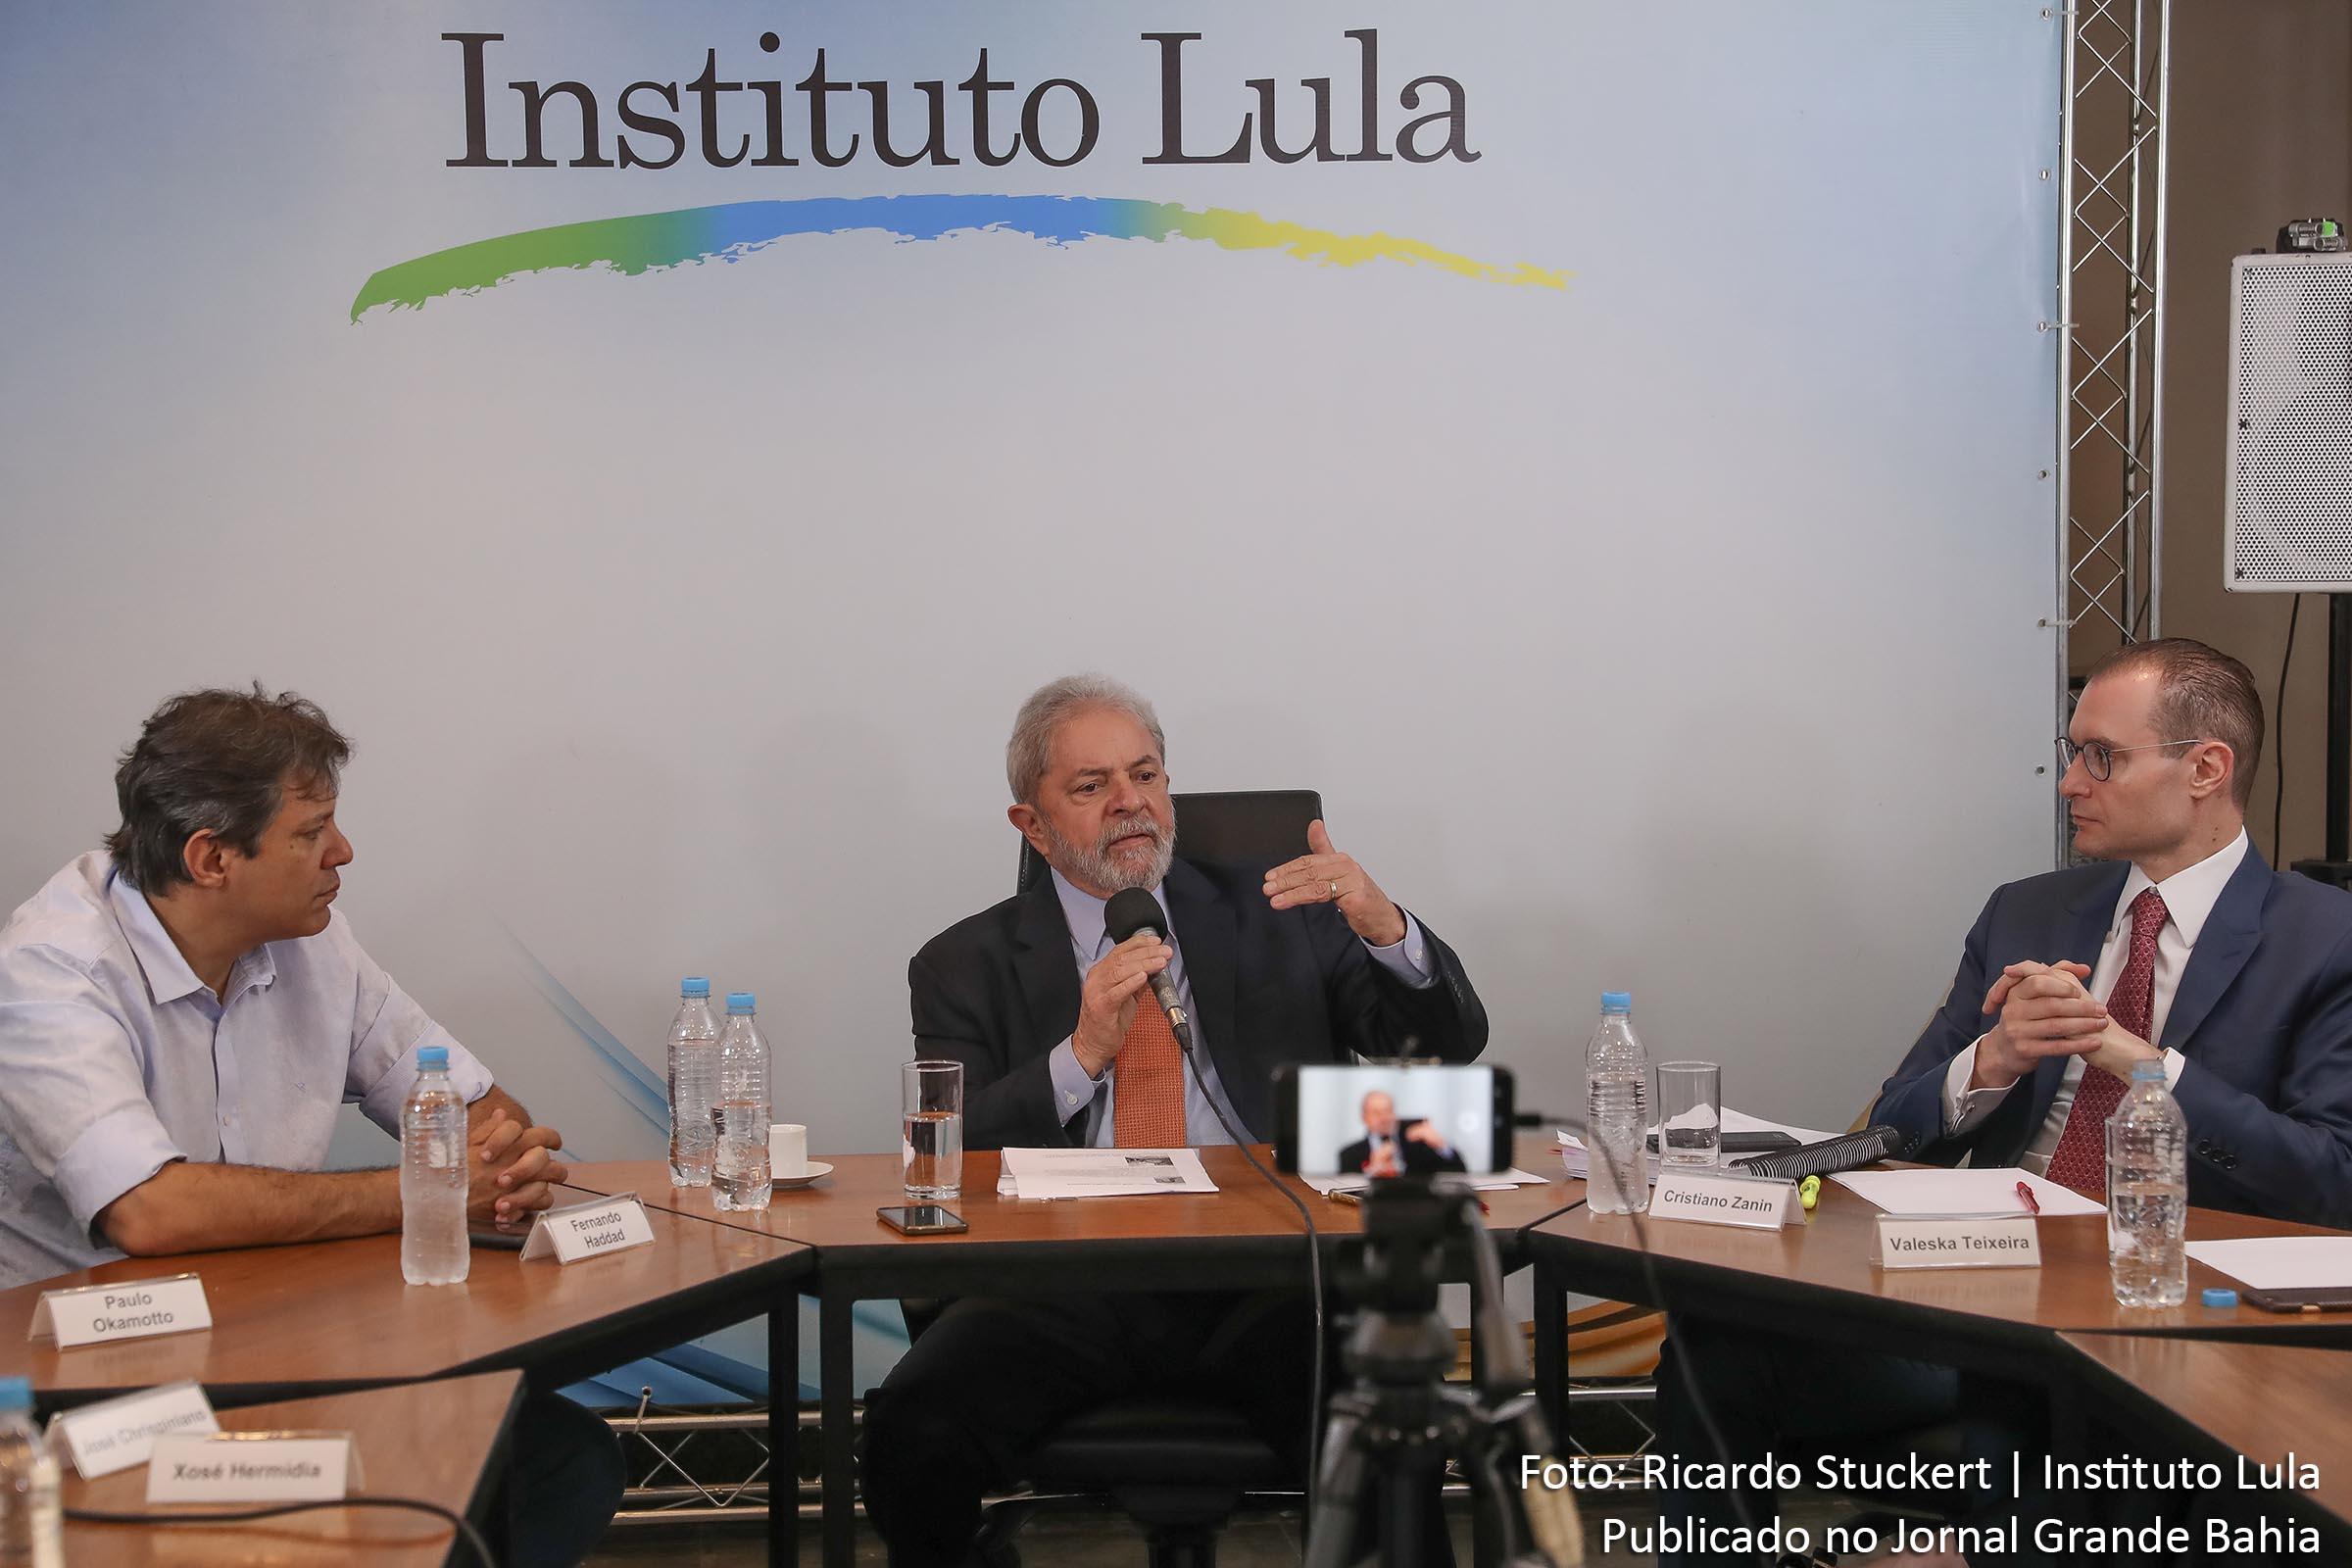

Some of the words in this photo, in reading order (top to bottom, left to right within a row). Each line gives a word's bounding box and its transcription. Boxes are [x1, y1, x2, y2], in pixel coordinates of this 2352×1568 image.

[441, 31, 1100, 171] Instituto
[1141, 28, 1483, 167] Lula
[1664, 1190, 1728, 1207] Cristiano
[1731, 1197, 1773, 1212] Zanin
[570, 1212, 621, 1232] Fernando
[584, 1229, 625, 1249] Haddad
[1890, 1237, 1957, 1250] Valeska
[1961, 1236, 2030, 1250] Teixeira
[104, 1293, 152, 1309] Paulo
[93, 1312, 173, 1333] Okamotto
